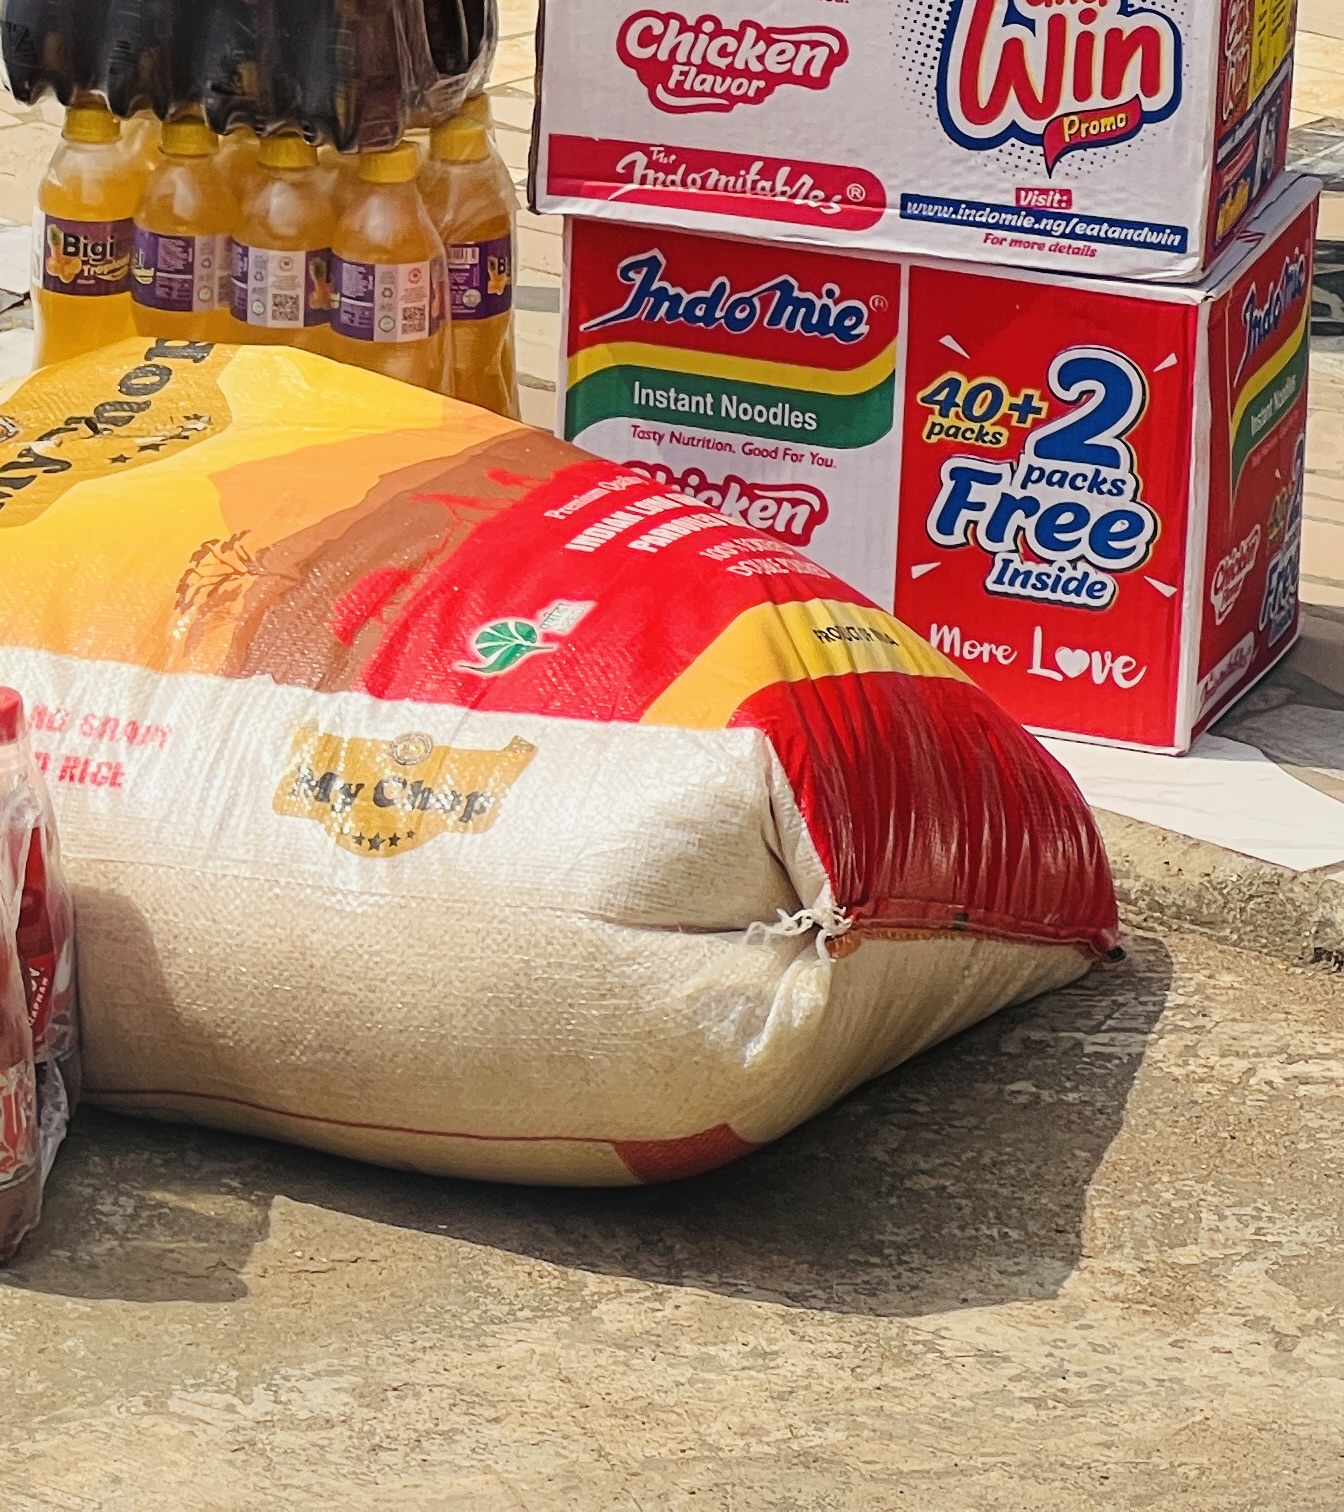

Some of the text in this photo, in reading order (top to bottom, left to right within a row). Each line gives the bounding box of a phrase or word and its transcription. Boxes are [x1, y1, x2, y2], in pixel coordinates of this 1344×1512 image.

[625, 15, 832, 78] Chicken
[667, 64, 766, 99] Flavor
[1062, 111, 1129, 143] Promo
[608, 151, 843, 215] Indomitables
[1018, 189, 1068, 208] Visit:
[906, 200, 1182, 247] www.indomie.ng/eatandwin
[63, 232, 117, 265] Bigi
[983, 233, 1098, 258] For more details
[634, 381, 818, 431] Instant Noodles
[920, 356, 1134, 469] 40+ 2
[631, 425, 837, 469] Tasty Nutrition. Good For You.
[926, 420, 1004, 446] packs
[1022, 464, 1126, 497] packs
[543, 482, 615, 521] Premium
[935, 466, 1146, 561] Free
[564, 505, 646, 554] INDIAN
[992, 558, 1108, 600] Inside
[930, 623, 1018, 664] More
[58, 755, 126, 789] RICE
[291, 765, 365, 814] My
